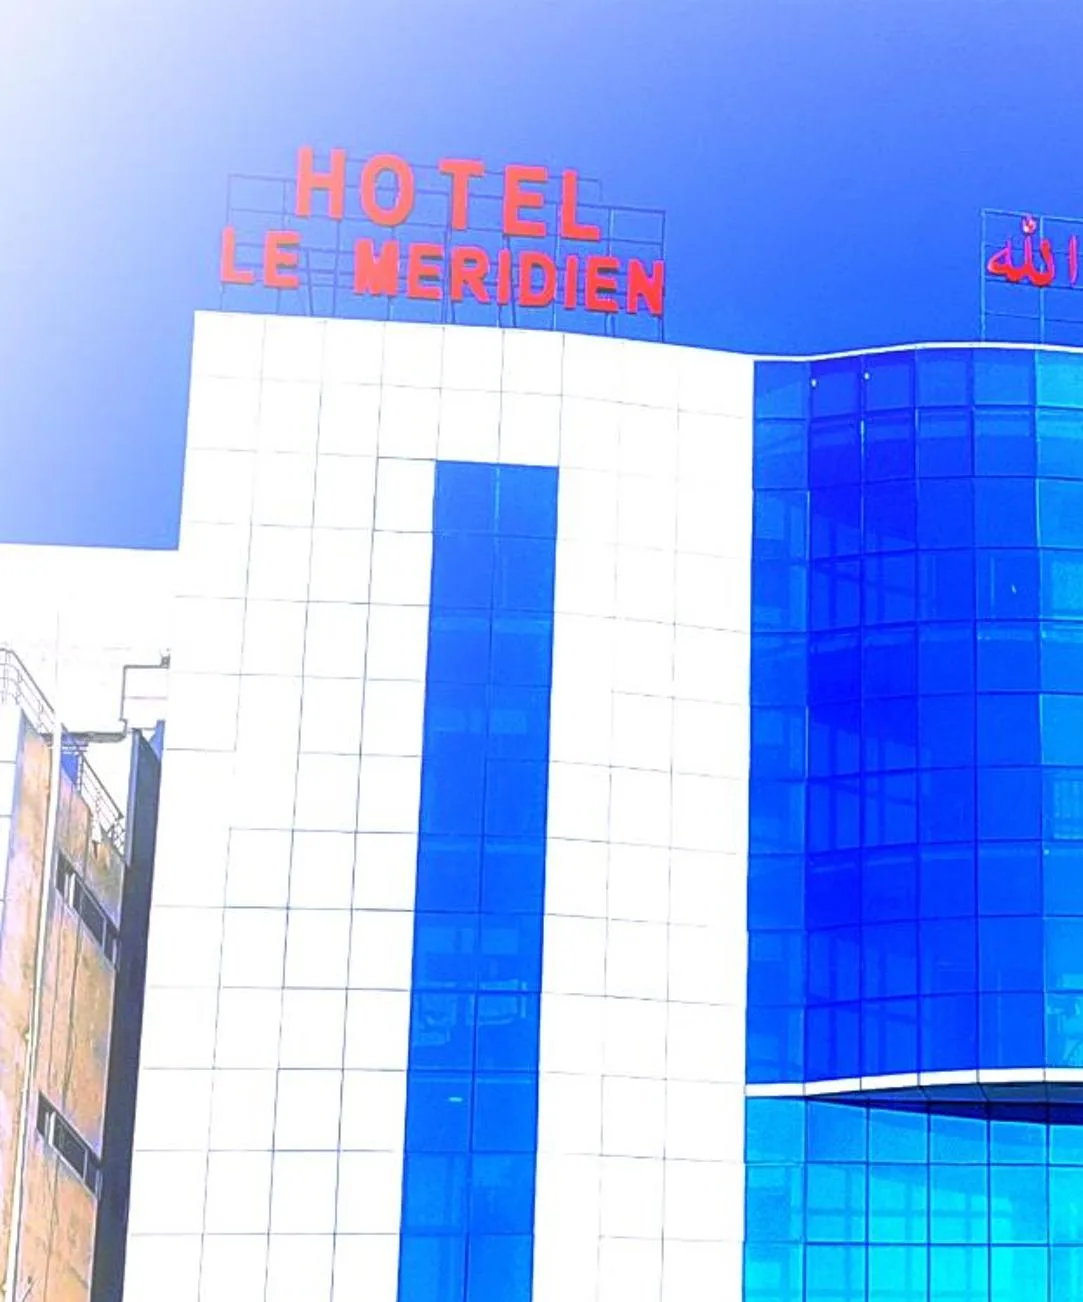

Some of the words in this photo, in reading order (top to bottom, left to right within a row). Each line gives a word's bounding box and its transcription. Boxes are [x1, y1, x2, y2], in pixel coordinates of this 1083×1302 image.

[295, 145, 600, 242] HOTEL
[220, 227, 299, 290] LE
[353, 238, 665, 316] MERIDIEN
